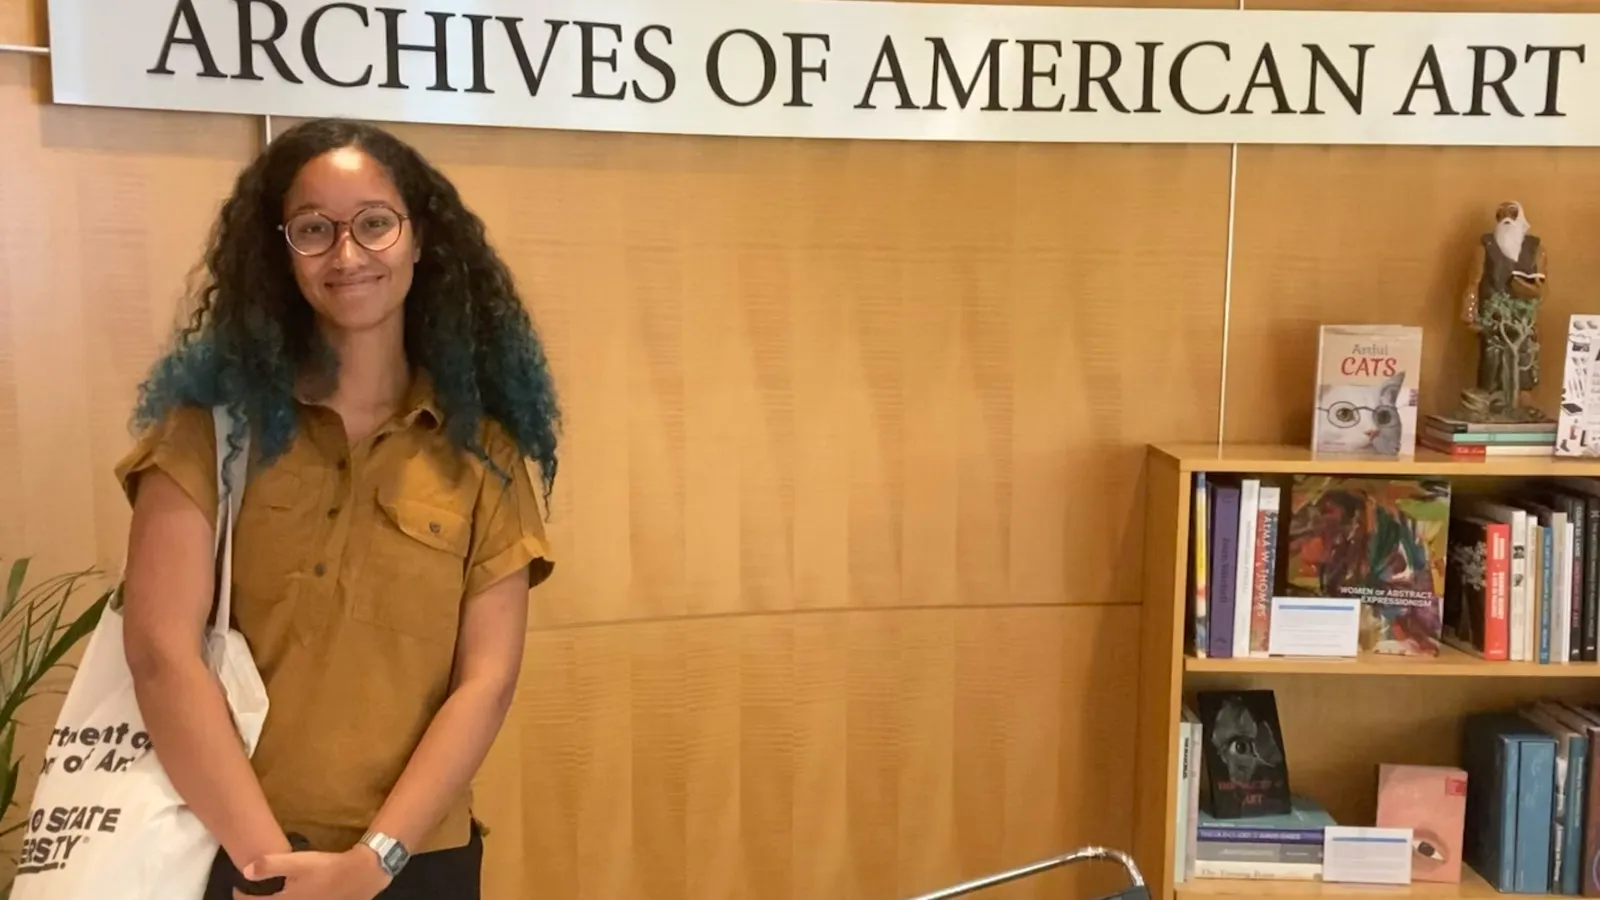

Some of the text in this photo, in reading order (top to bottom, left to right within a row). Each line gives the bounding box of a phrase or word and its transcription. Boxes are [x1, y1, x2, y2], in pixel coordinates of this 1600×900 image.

[146, 0, 1585, 118] ARCHIVES OF AMERICAN ART
[1352, 344, 1388, 355] Artful
[1341, 356, 1397, 377] CATS
[1261, 515, 1272, 547] ALMA
[1256, 569, 1270, 617] THOMAS
[1340, 586, 1374, 595] WOMEN
[1386, 590, 1433, 599] ABSTRACT
[1361, 596, 1432, 607] EXPRESSIONISM
[45, 806, 121, 833] STATE
